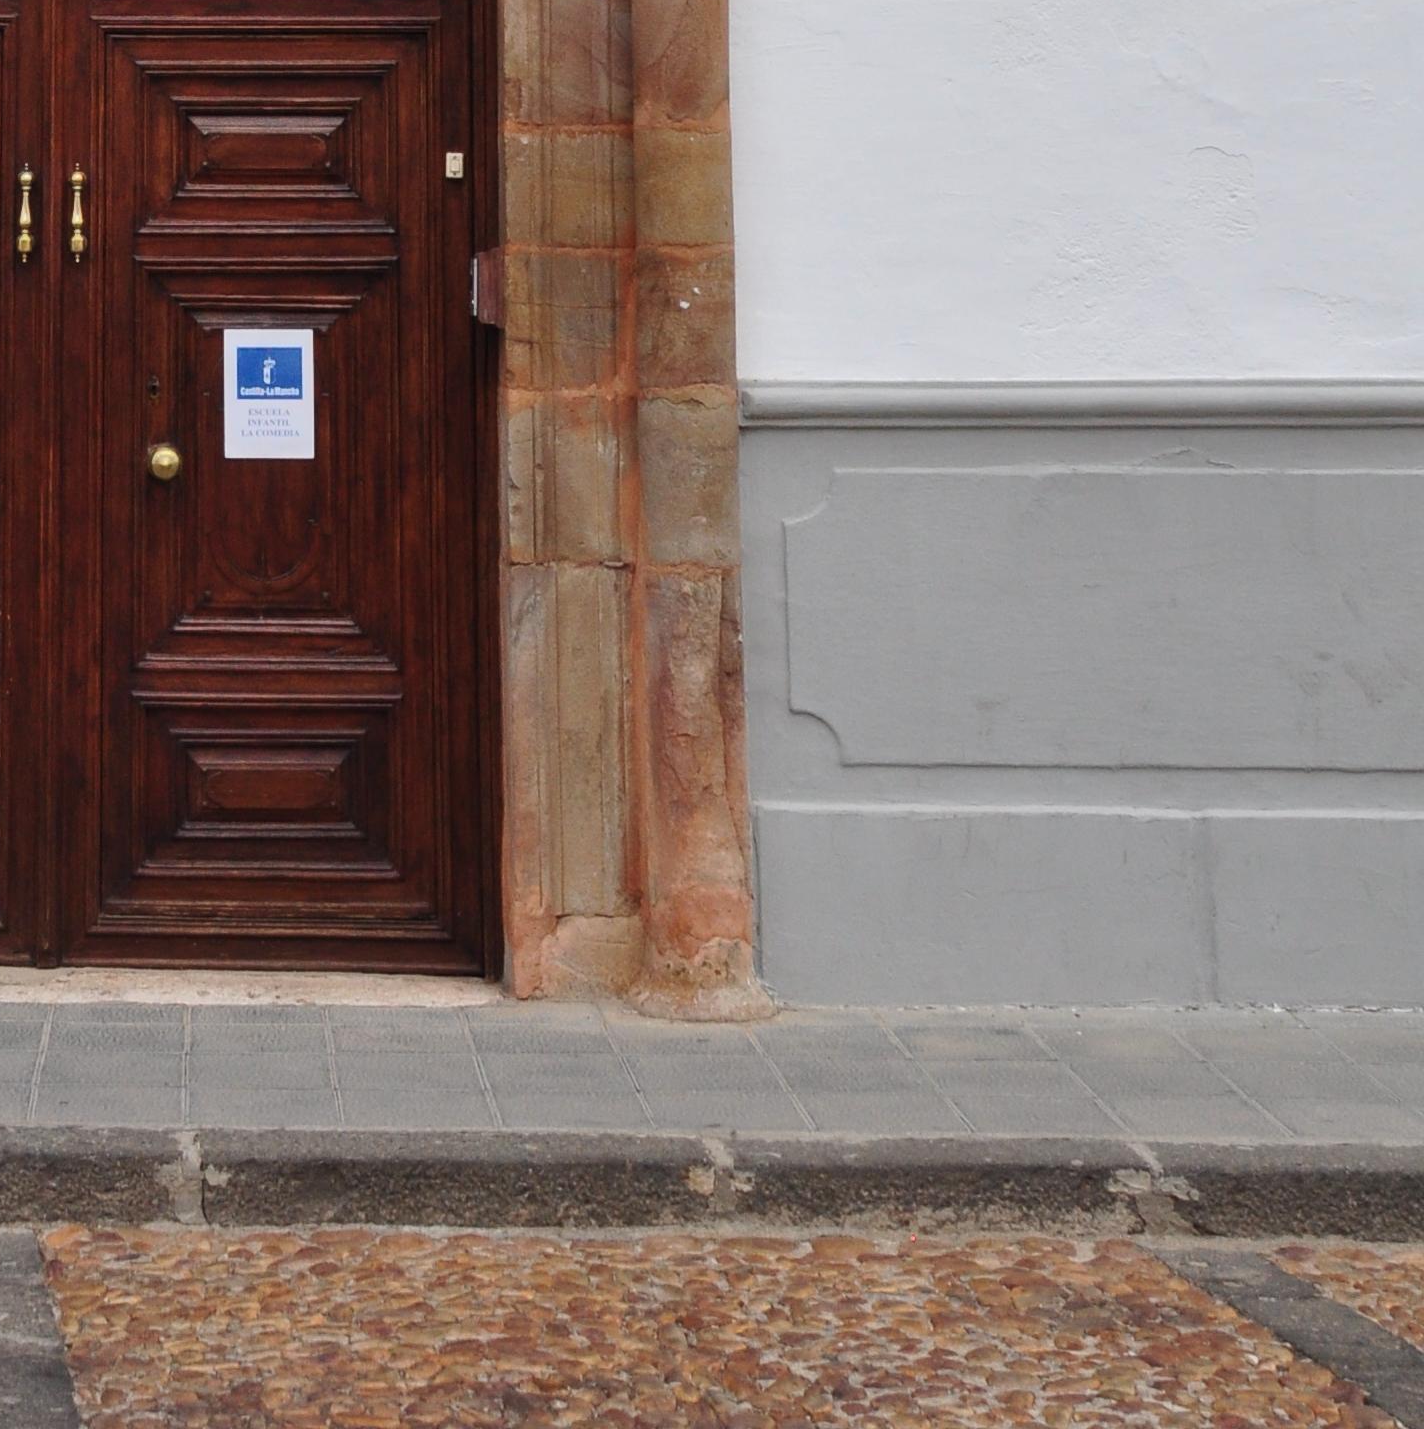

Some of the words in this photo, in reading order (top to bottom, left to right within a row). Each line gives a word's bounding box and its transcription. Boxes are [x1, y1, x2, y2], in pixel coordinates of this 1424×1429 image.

[248, 408, 290, 416] ESCUELA
[248, 419, 290, 427] INFANTIL
[241, 429, 253, 437] LA
[255, 429, 300, 437] COMEDIA
